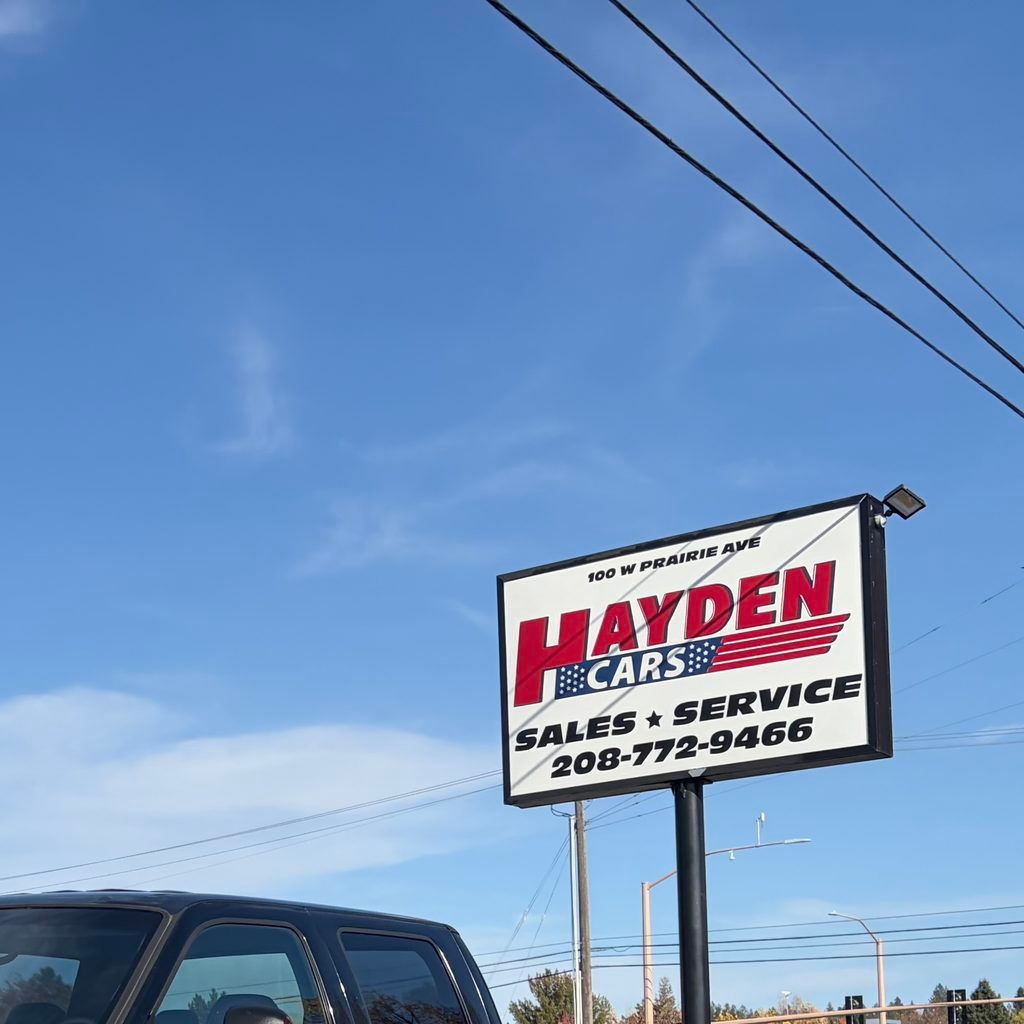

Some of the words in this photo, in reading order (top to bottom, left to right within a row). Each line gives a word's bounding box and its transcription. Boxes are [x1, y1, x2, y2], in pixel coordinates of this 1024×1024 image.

[587, 568, 616, 583] 100
[620, 563, 636, 576] W
[640, 545, 718, 572] PRAIRIE
[721, 537, 761, 555] AVE
[514, 560, 836, 707] HAYDEN
[586, 646, 686, 691] CARS
[515, 711, 637, 752] SALES
[673, 674, 863, 726] SERVICE
[551, 717, 814, 778] 208-772-9466
